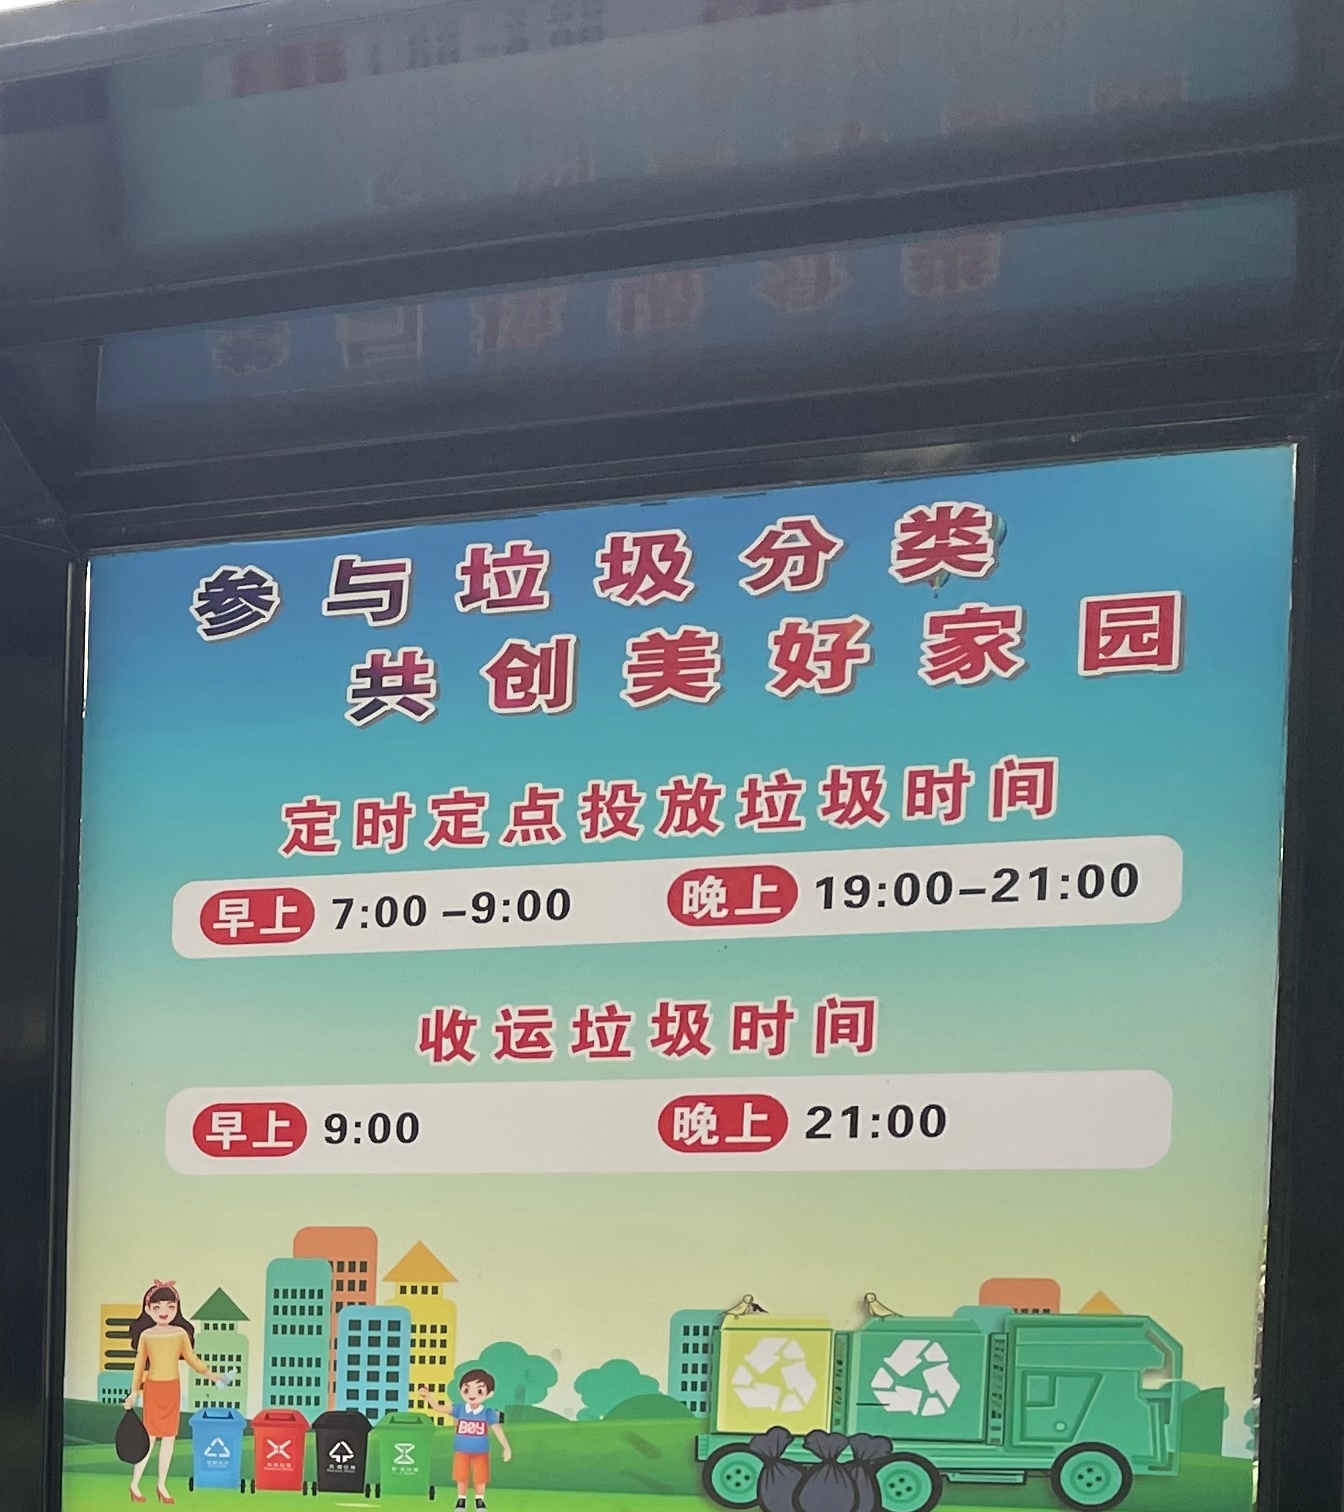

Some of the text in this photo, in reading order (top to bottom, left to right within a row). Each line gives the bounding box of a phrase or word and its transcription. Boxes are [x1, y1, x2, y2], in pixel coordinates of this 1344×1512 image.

[194, 502, 994, 641] 参与垃圾分类
[345, 591, 1185, 727] 共创美好家园
[279, 754, 1060, 858] 定时定点投放垃圾时间
[213, 895, 302, 938] 早上
[682, 873, 782, 920] 晚上
[418, 996, 879, 1066] 收运垃圾时间
[205, 1111, 420, 1151] 早上 9:00
[673, 1102, 947, 1146] 晚上 21:00
[458, 1420, 485, 1435] BOY
